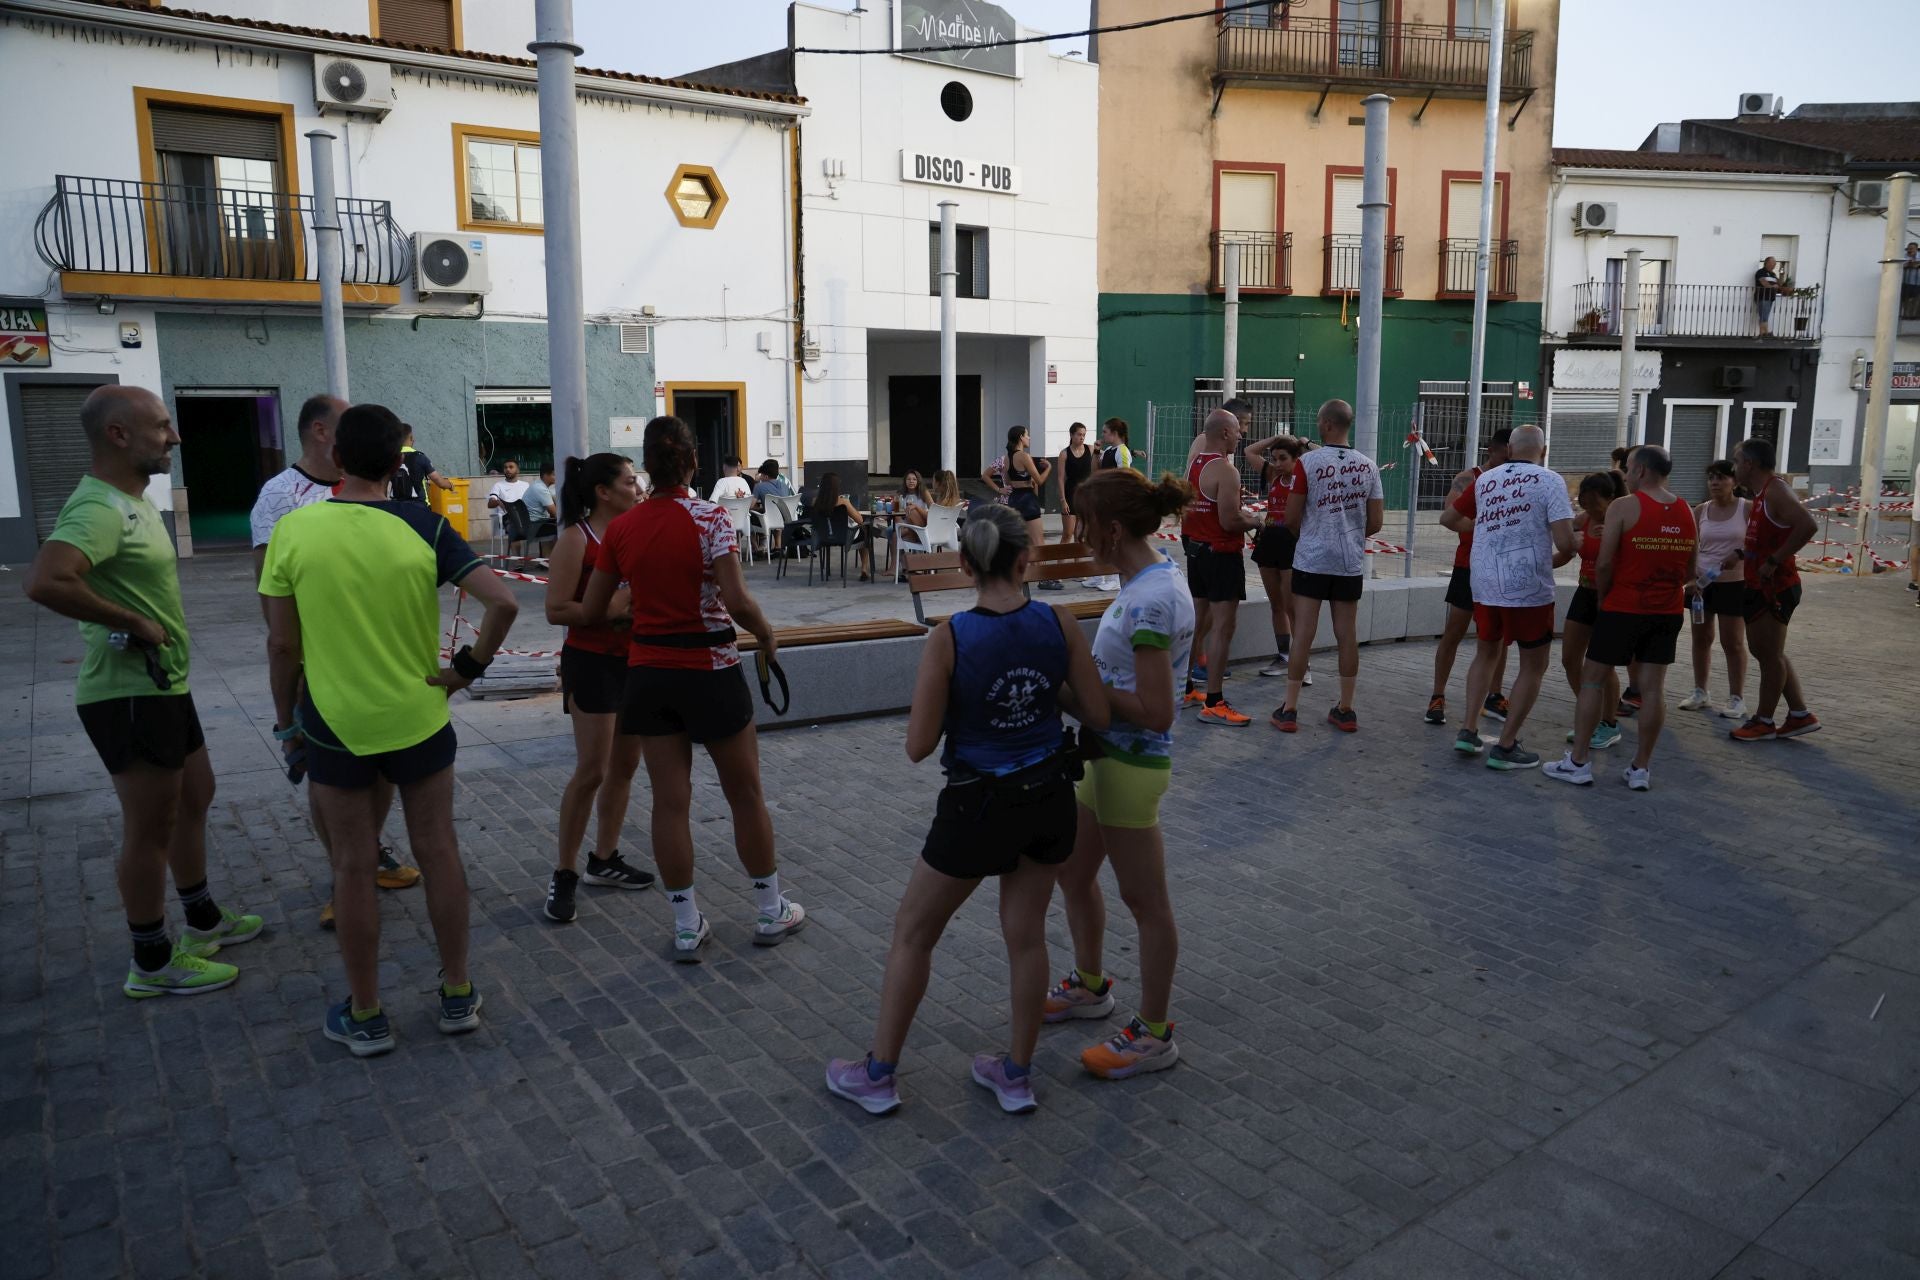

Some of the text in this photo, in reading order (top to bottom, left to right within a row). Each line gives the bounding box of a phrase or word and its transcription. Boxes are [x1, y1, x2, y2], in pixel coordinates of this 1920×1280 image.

[915, 154, 964, 183] DISCO
[981, 164, 1012, 190] PUB
[1316, 461, 1371, 481] 20 años
[1327, 474, 1364, 491] con el
[1480, 473, 1540, 497] 20 años
[1486, 486, 1525, 507] con el
[1661, 525, 1681, 534] PACO
[1635, 543, 1660, 551] CIUDAD
[985, 677, 1006, 701] CLUB
